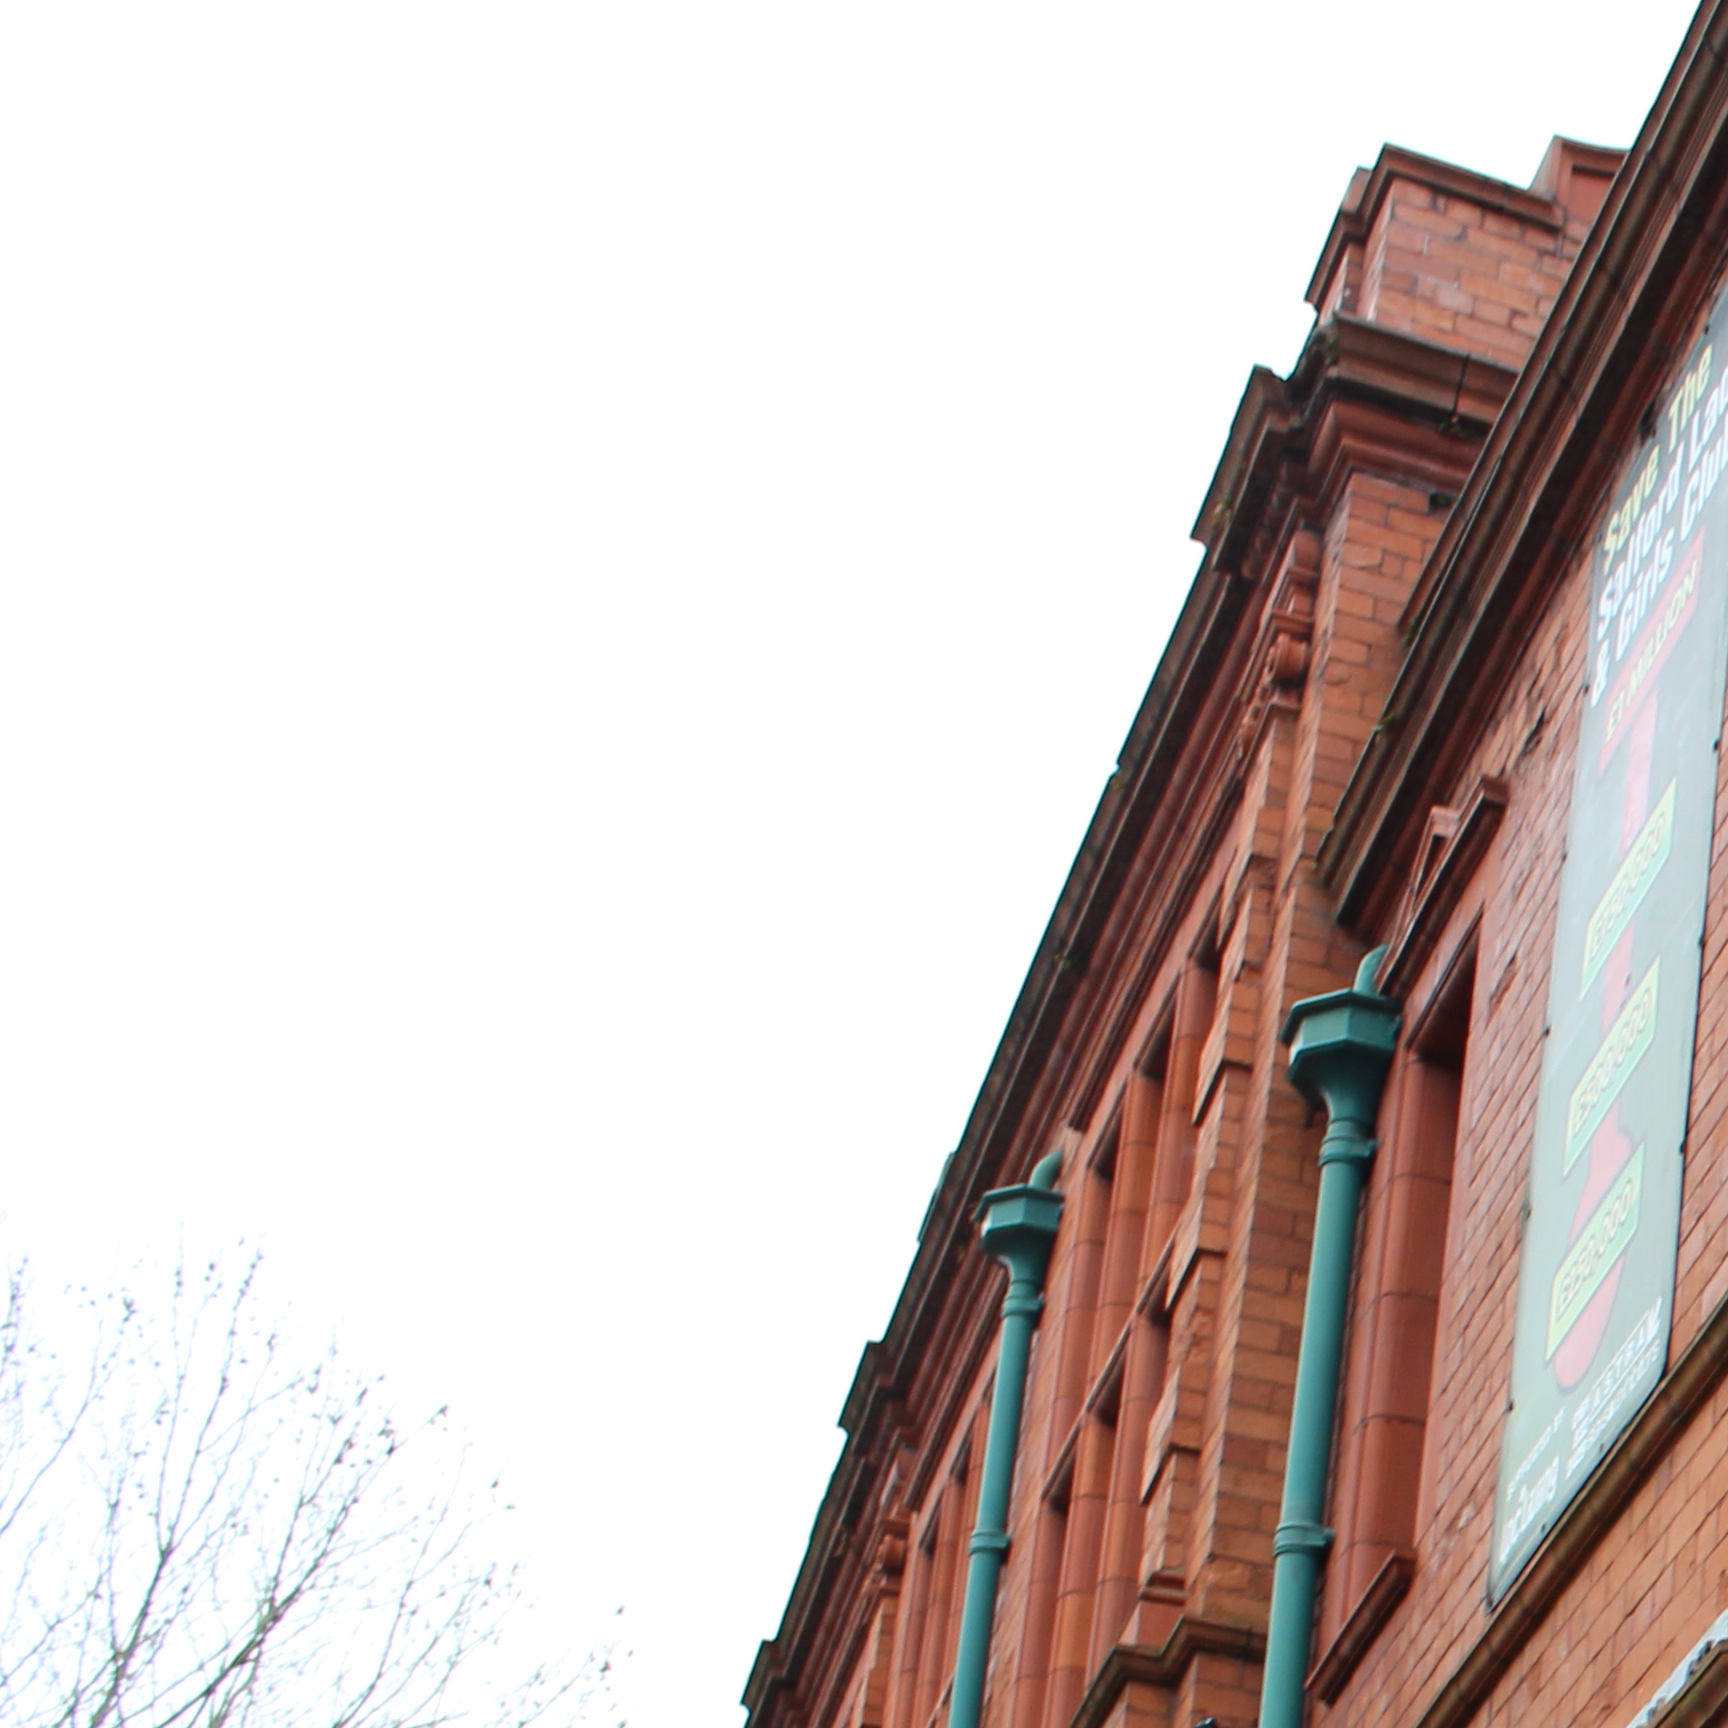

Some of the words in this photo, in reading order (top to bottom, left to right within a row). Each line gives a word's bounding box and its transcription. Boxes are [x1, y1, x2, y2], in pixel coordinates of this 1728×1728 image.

[1597, 440, 1685, 643] Salford
[1603, 441, 1660, 577] Save
[1667, 341, 1712, 455] The
[1591, 637, 1609, 708] &
[1616, 525, 1675, 664] Girls
[1626, 558, 1698, 706] MILLION
